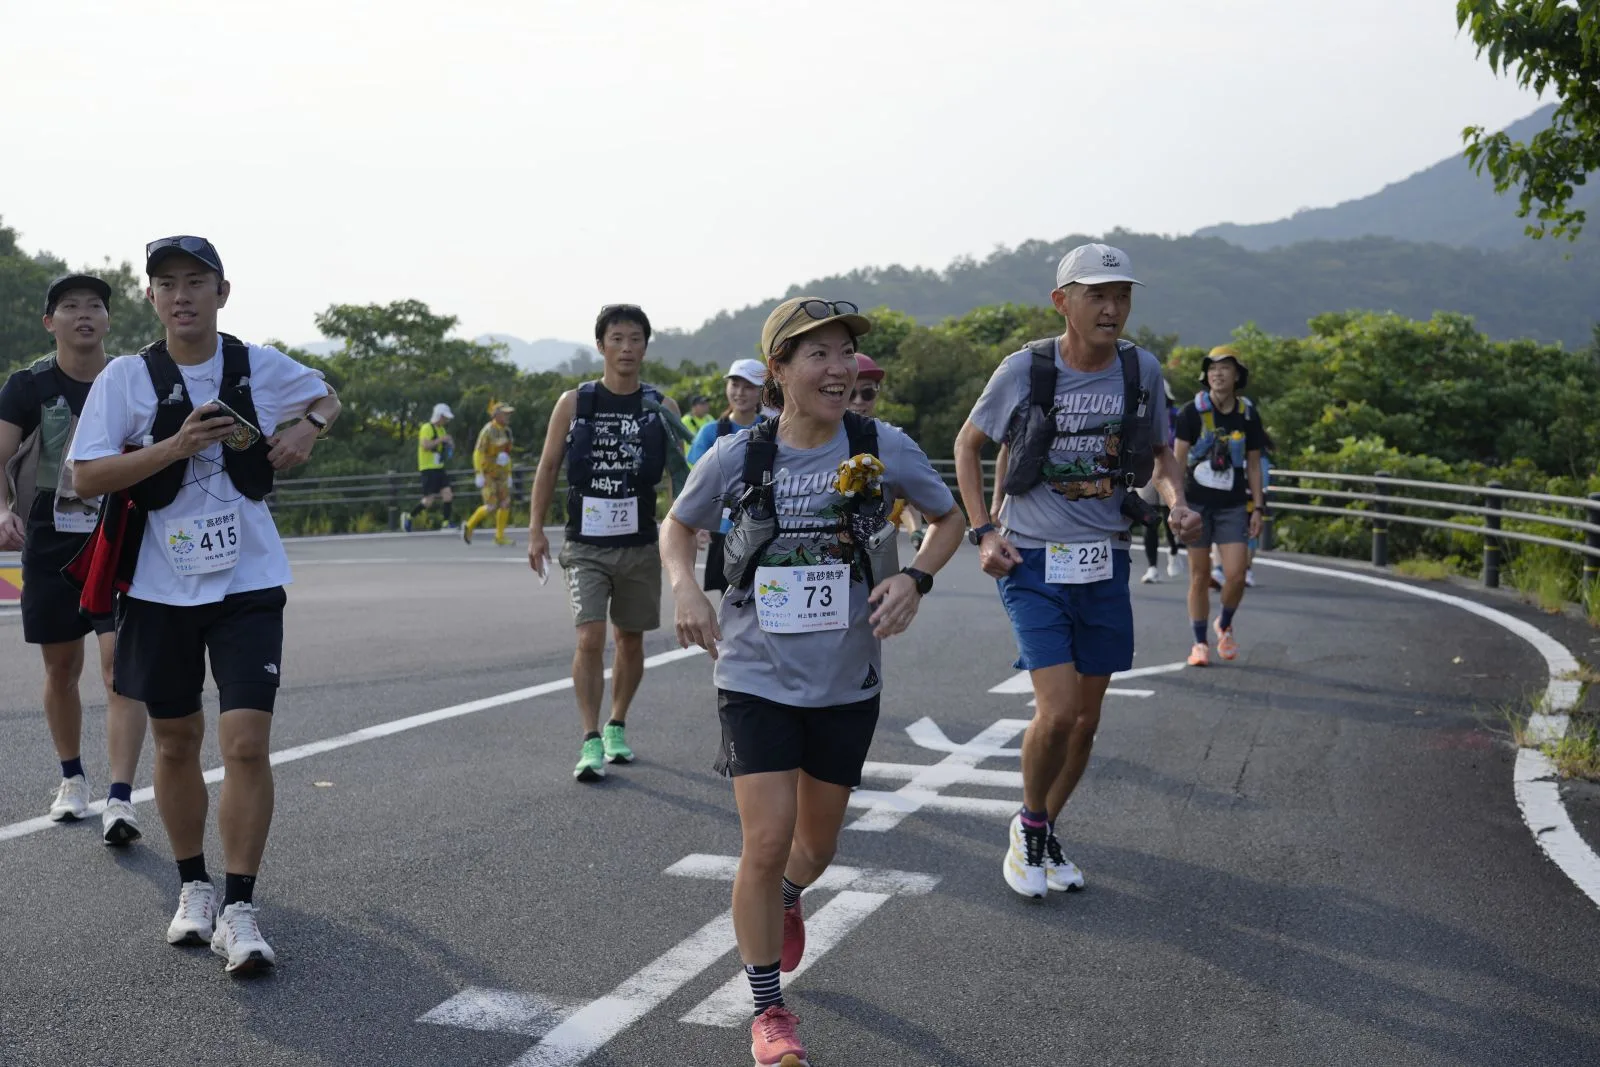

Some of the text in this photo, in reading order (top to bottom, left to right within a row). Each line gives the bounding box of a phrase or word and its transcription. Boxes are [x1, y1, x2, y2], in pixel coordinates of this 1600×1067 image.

[1054, 393, 1124, 415] SHIZUCH
[621, 419, 640, 435] RA
[605, 451, 618, 461] TO
[591, 476, 622, 495] HEAT
[611, 510, 628, 522] 72
[200, 526, 237, 551] 415
[1079, 545, 1108, 565] 224
[806, 570, 844, 582] 高砂熱学
[804, 585, 832, 609] 73
